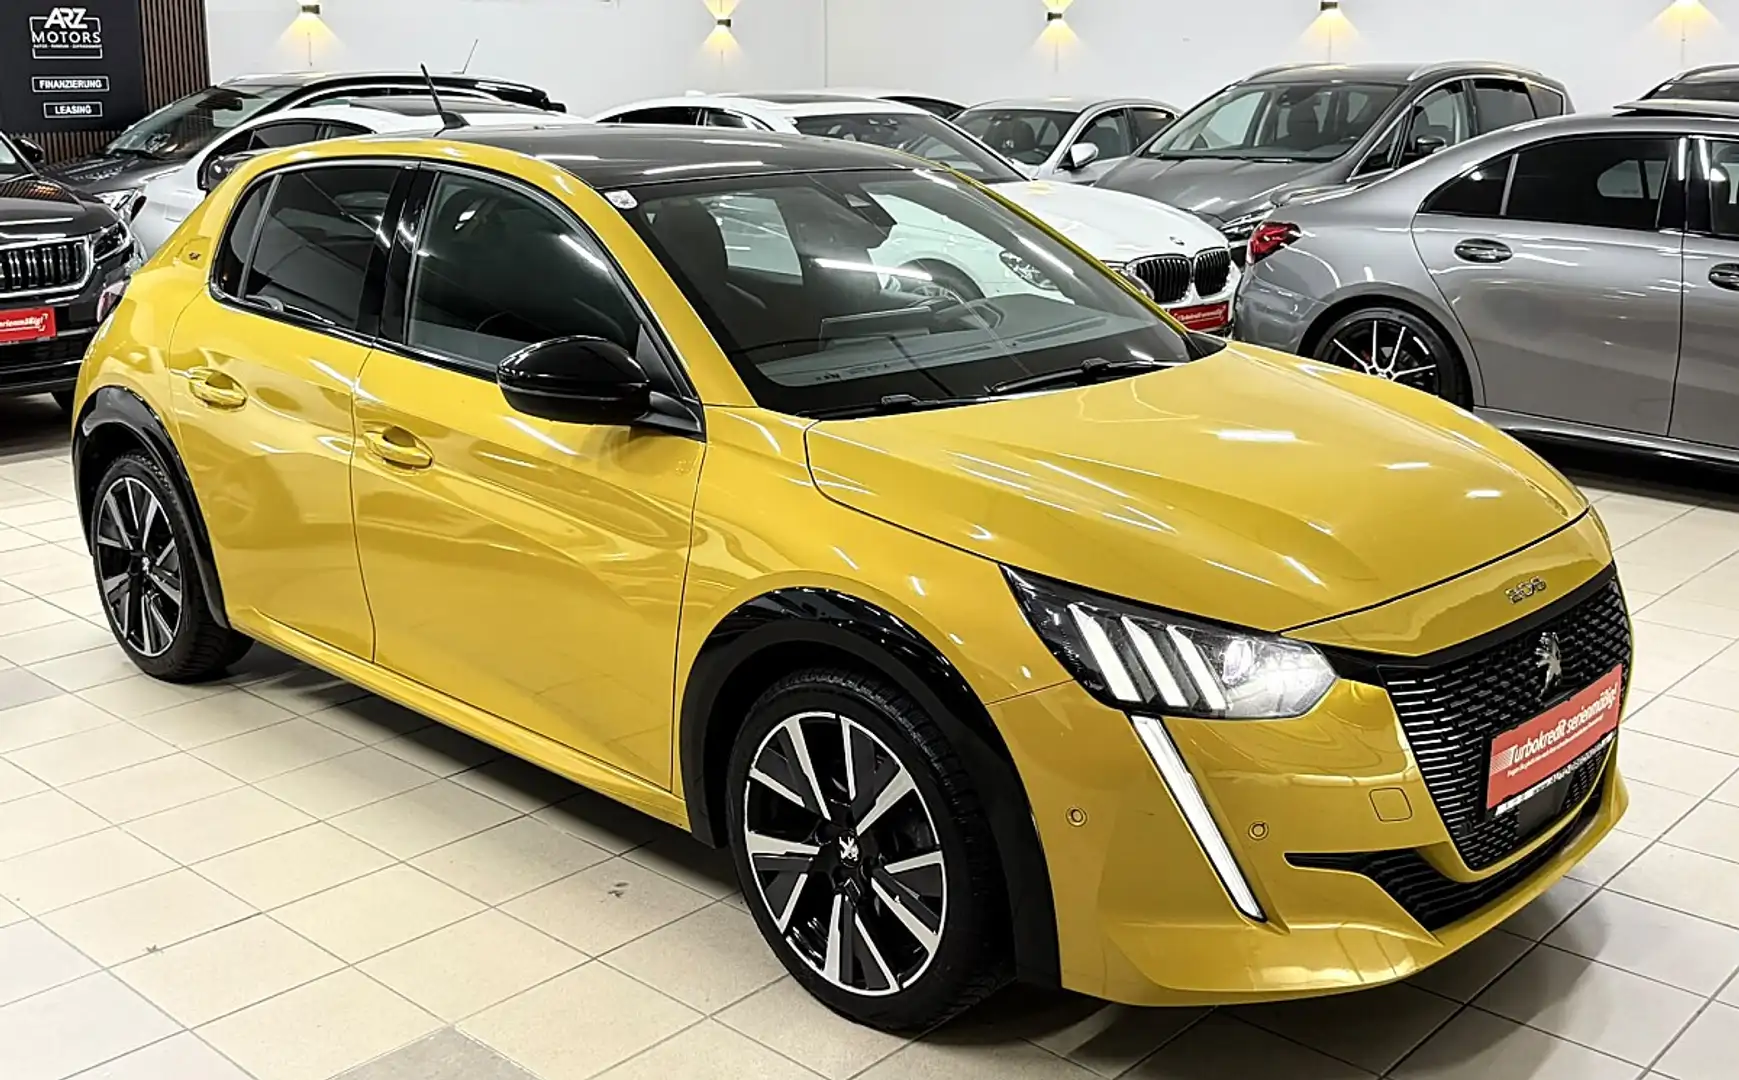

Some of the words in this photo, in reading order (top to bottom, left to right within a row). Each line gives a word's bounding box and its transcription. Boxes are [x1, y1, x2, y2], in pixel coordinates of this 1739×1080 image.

[44, 7, 88, 29] ARZ
[32, 31, 101, 43] MOTORS
[39, 79, 102, 89] FINANZIERUNG
[54, 105, 92, 114] LEASING
